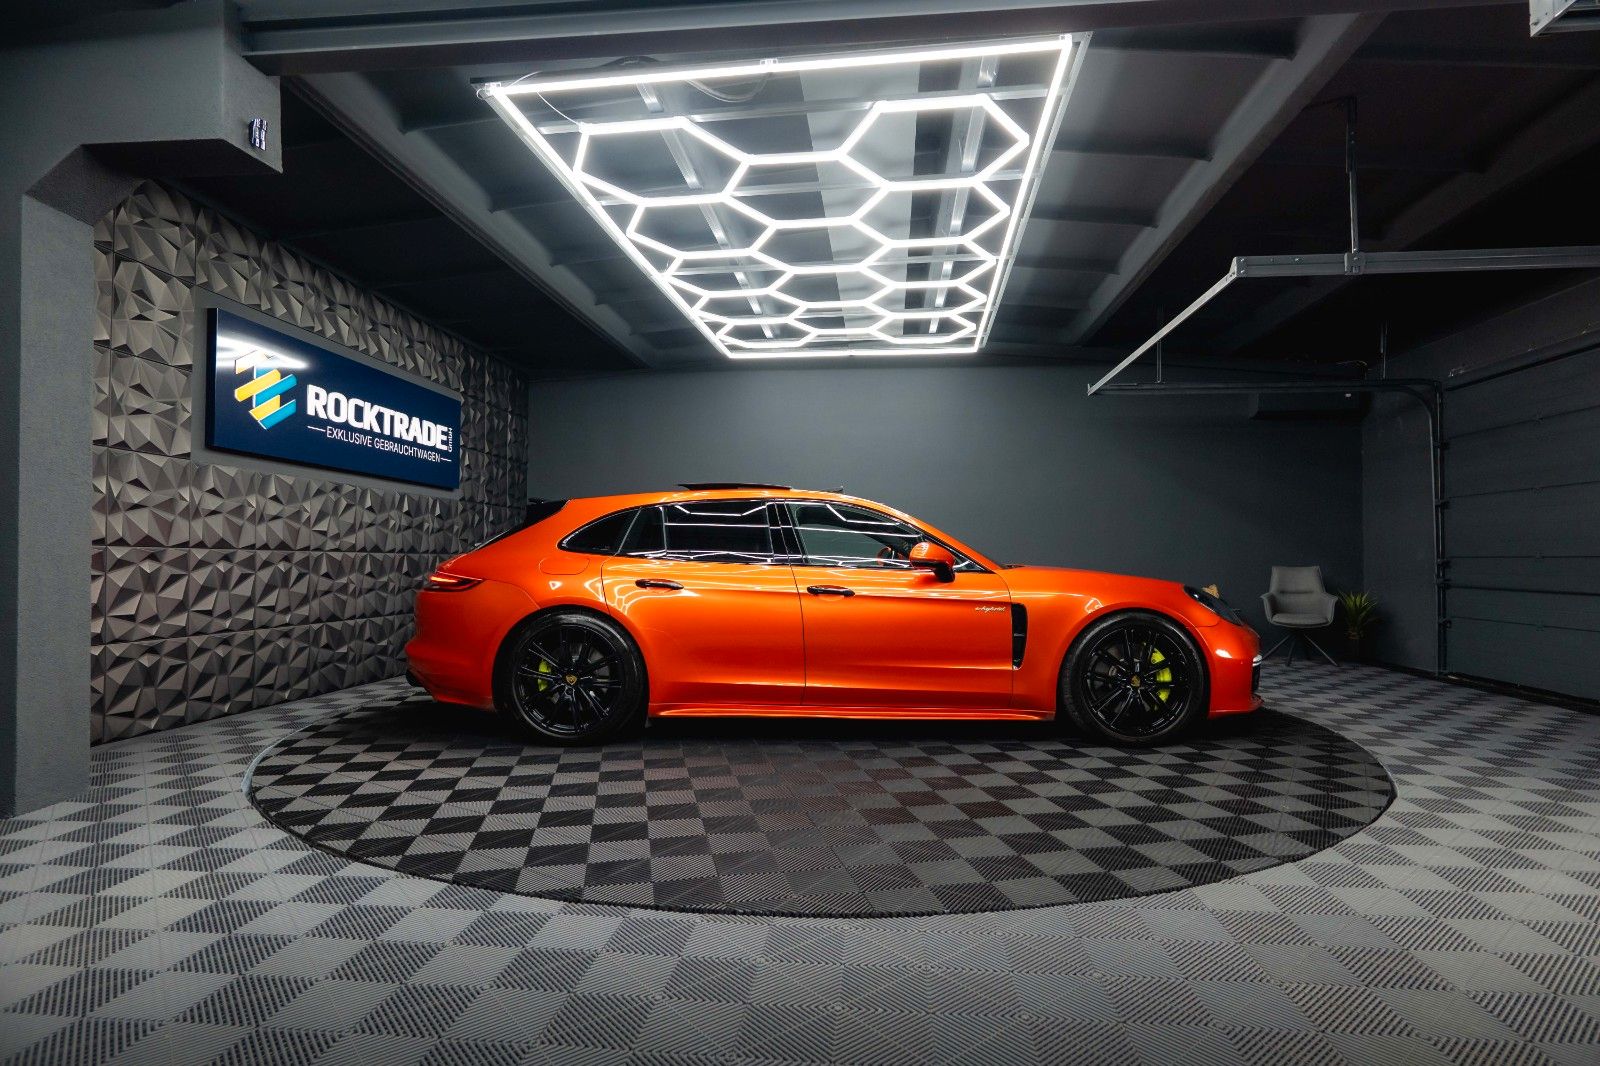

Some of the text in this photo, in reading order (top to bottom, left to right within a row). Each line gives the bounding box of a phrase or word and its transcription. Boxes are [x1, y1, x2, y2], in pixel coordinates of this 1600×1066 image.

[307, 384, 449, 451] ROCKTRADE
[326, 426, 440, 463] EXKLUSIVE GEBRAUCHTWAGEN
